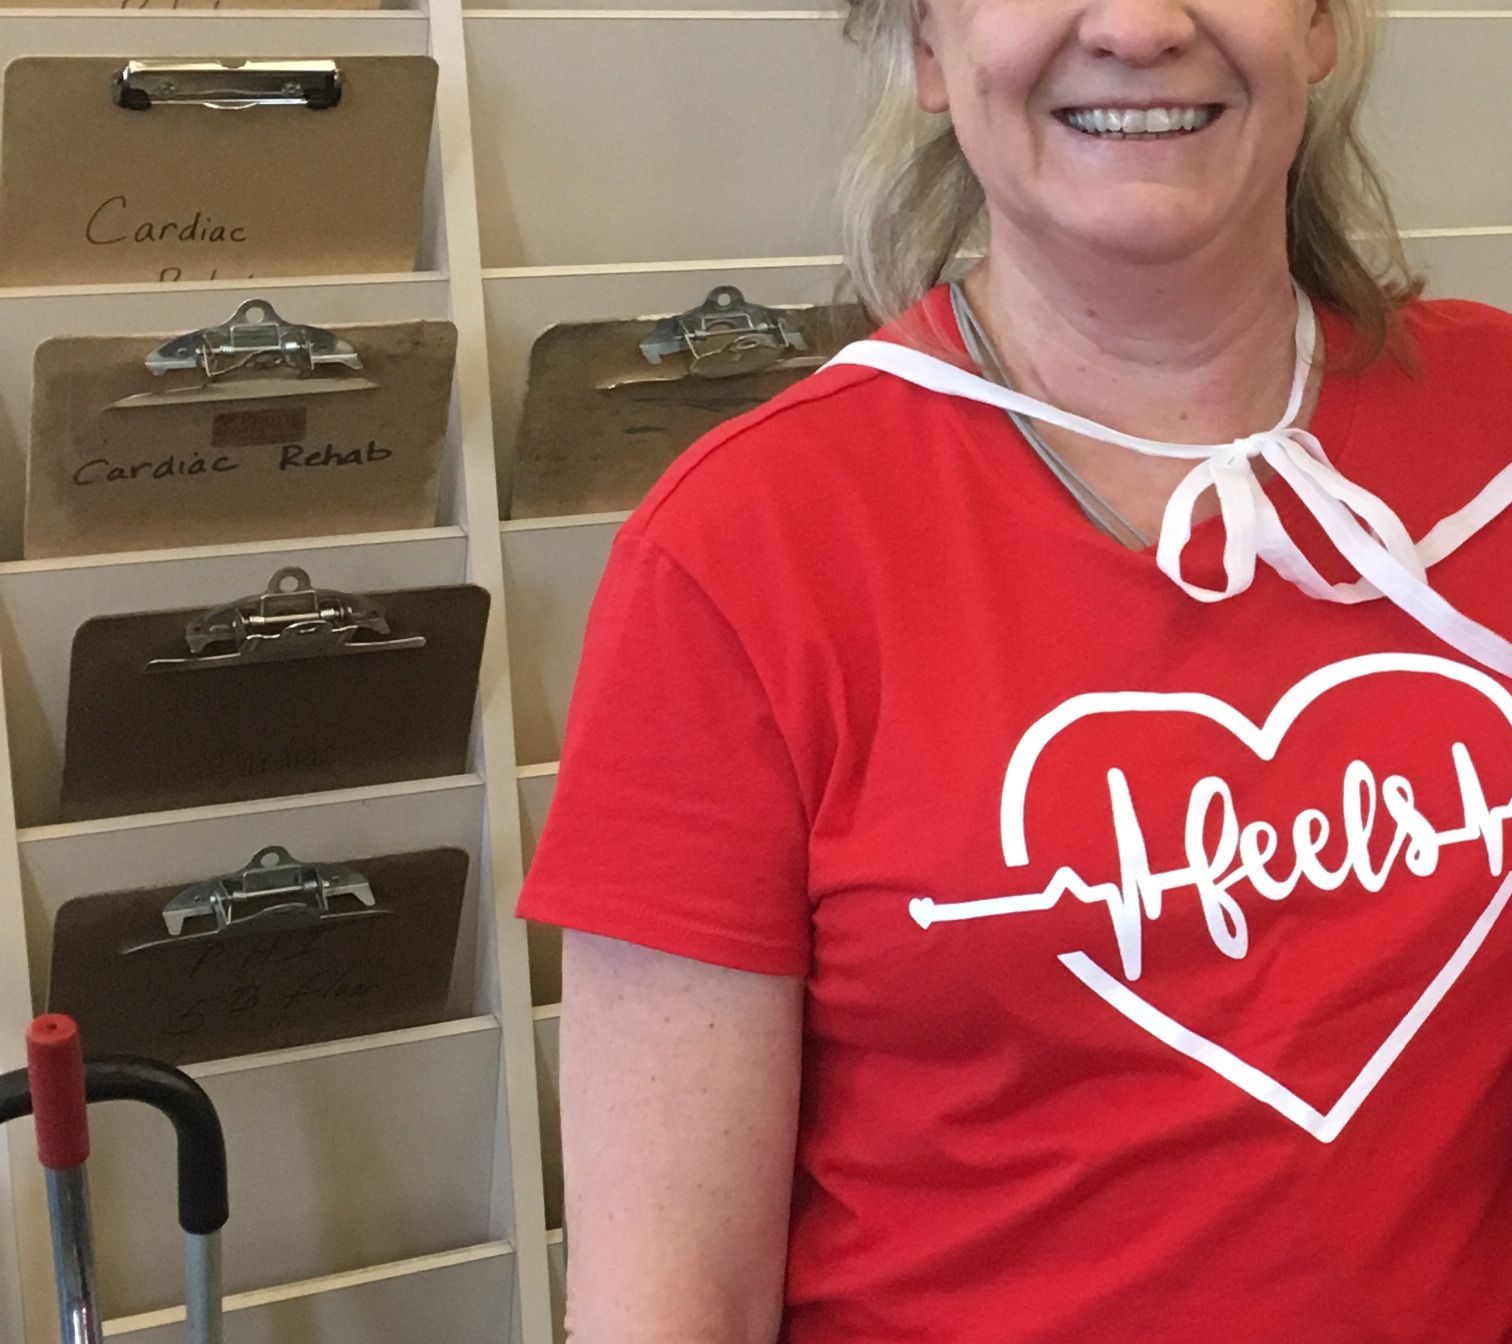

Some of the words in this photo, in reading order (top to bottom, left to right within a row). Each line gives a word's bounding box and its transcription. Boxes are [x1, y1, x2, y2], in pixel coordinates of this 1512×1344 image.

[85, 196, 247, 246] Cardiac
[72, 452, 240, 486] Cardiac
[279, 440, 393, 471] Rehab
[1185, 760, 1440, 959] feels
